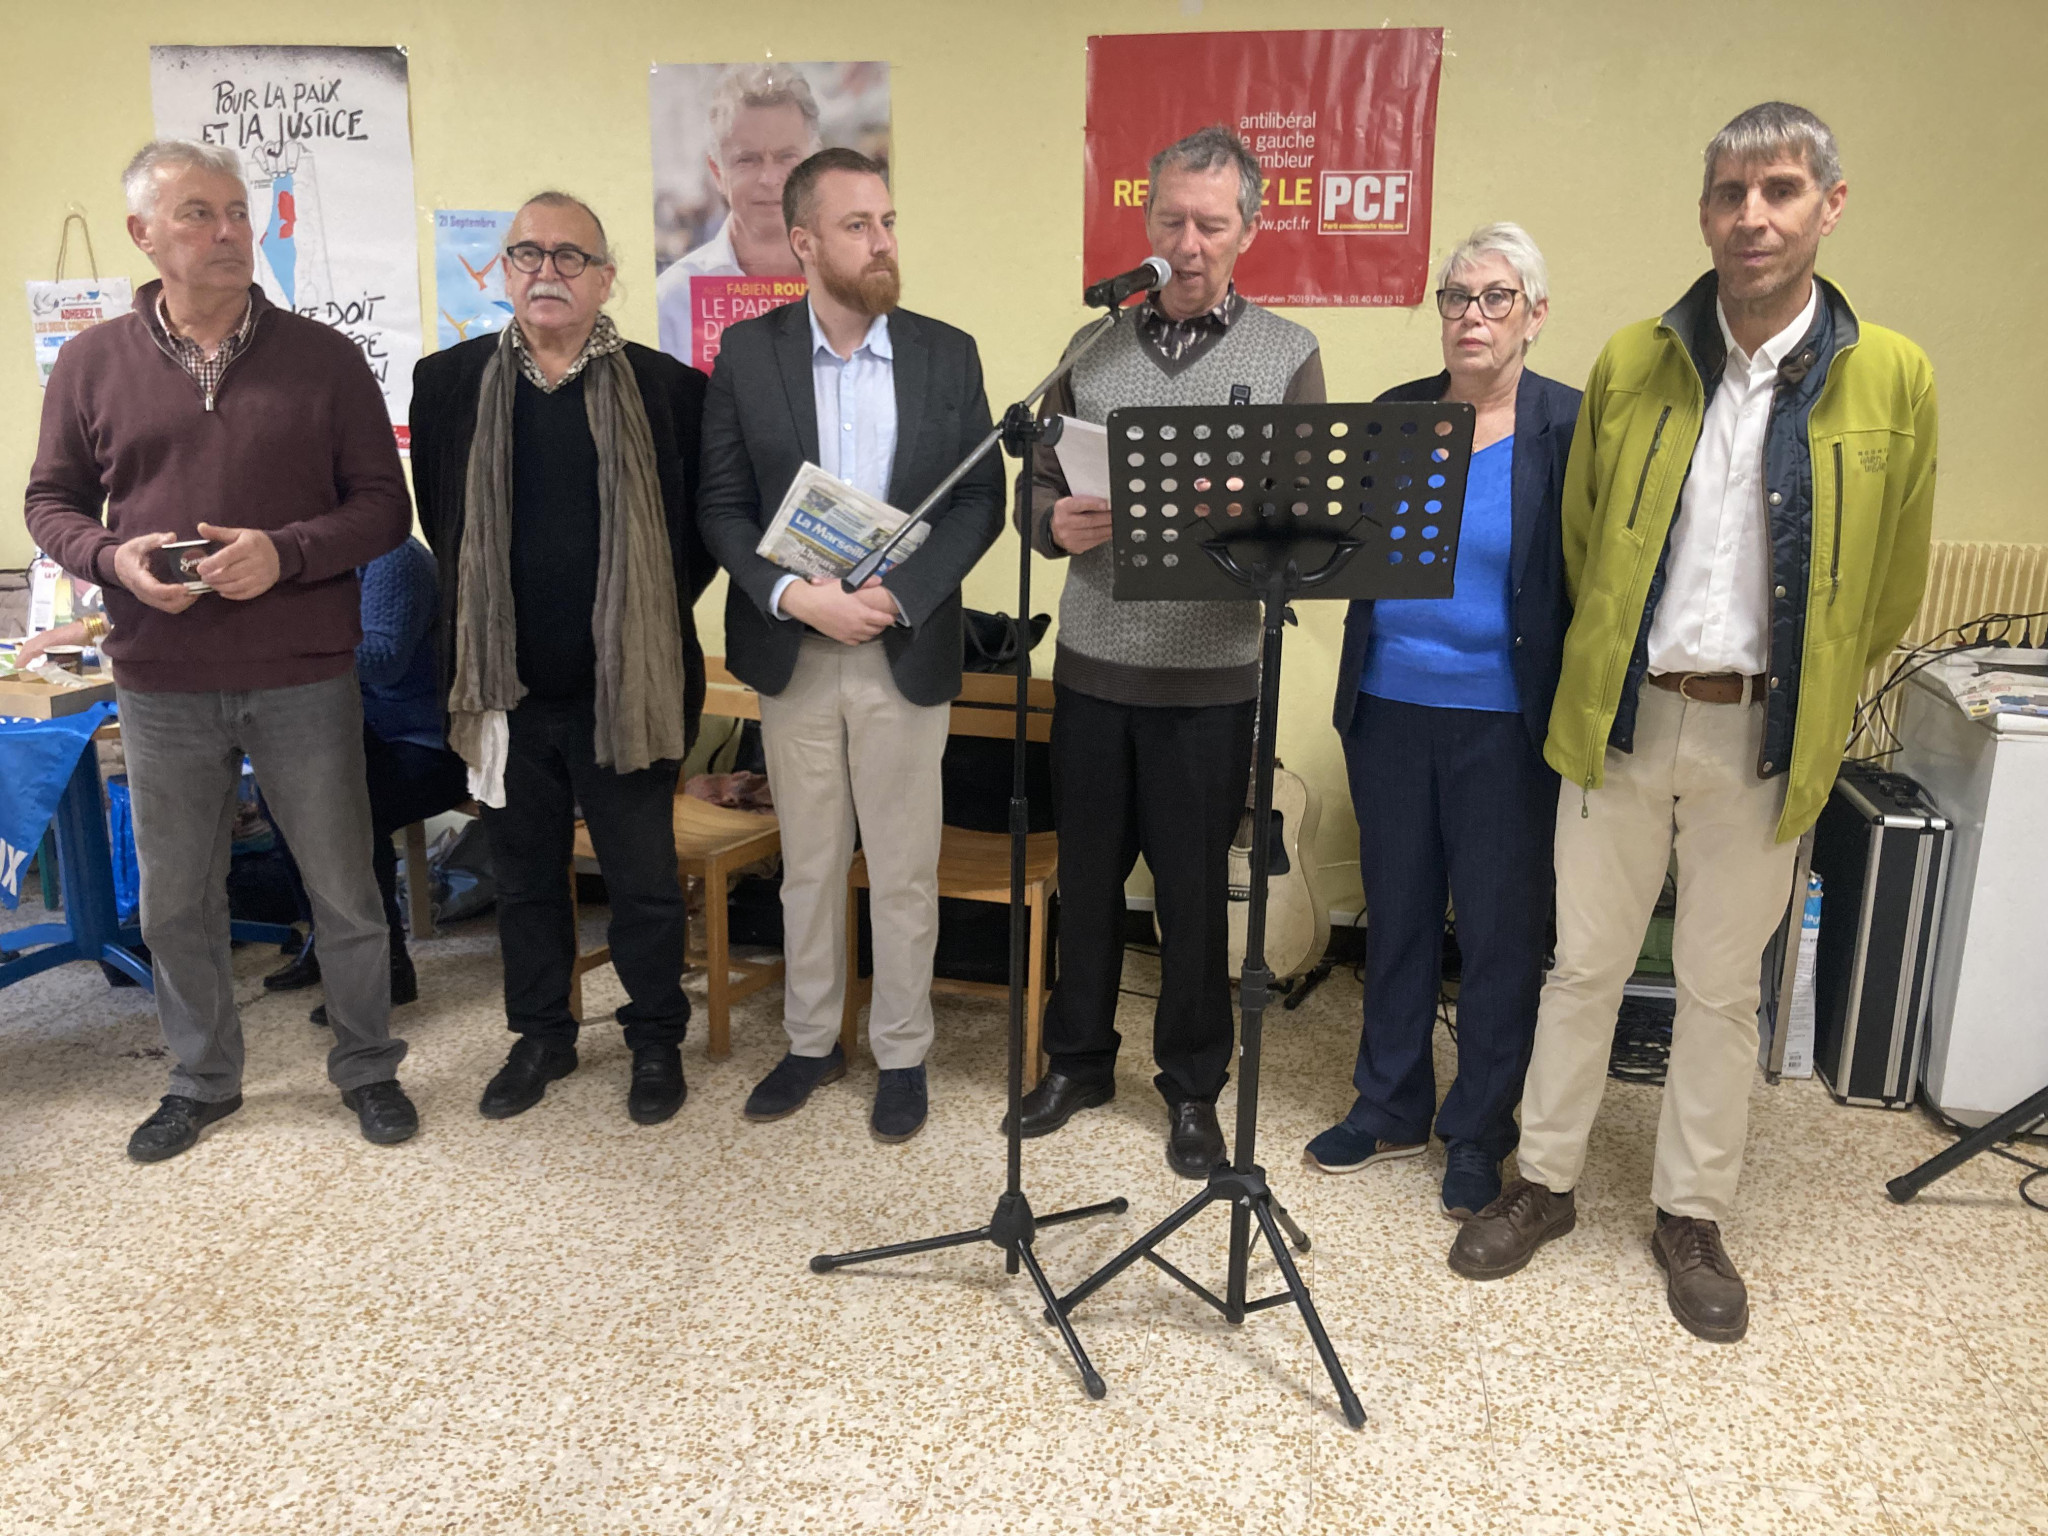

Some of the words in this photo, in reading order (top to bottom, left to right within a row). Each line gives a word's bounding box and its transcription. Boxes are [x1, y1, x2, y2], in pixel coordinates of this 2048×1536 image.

[212, 80, 259, 115] POUR
[264, 82, 287, 109] LA
[293, 78, 342, 113] PAIX
[1240, 110, 1316, 129] antilibéral
[202, 122, 229, 145] ET
[238, 113, 264, 149] LA
[267, 108, 369, 158] JUSTICE
[1255, 130, 1315, 152] gauche
[1259, 151, 1314, 168] mbleur
[1278, 179, 1312, 206] LE
[1324, 175, 1408, 221] PCF
[450, 216, 497, 229] Septembre
[1260, 216, 1311, 233] w.pcf.fr
[726, 283, 771, 296] FABIEN
[773, 282, 810, 297] ROU
[702, 299, 725, 319] LE
[732, 299, 790, 319] PART
[794, 512, 812, 530] La
